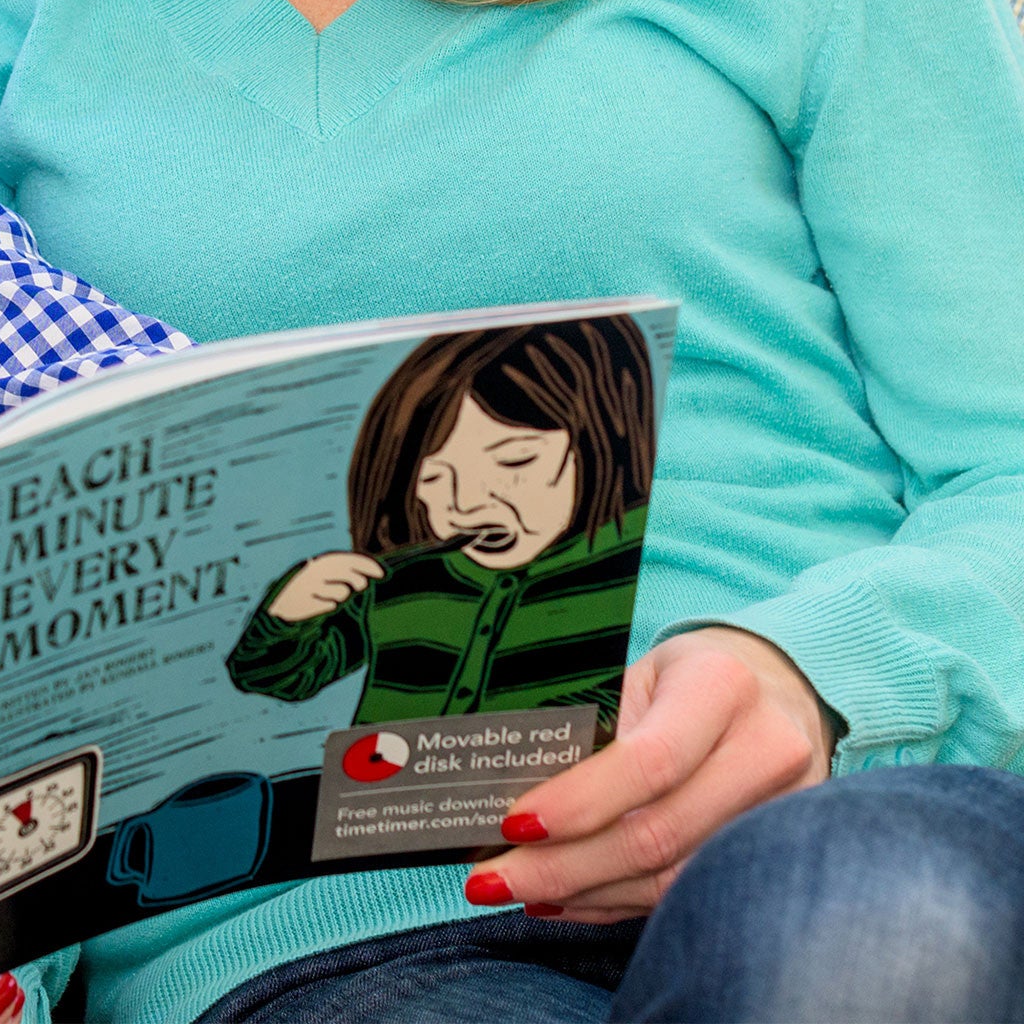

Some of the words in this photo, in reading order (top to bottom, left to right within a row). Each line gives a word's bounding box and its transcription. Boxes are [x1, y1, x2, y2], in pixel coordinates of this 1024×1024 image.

[9, 436, 154, 523] EACH
[4, 467, 218, 574] MINUTE
[1, 527, 179, 623] EVERY
[413, 755, 463, 775] disk
[470, 745, 582, 771] included!
[417, 726, 522, 752] Movable
[529, 722, 573, 744] red
[337, 807, 377, 822] Free
[382, 799, 435, 817] music
[439, 794, 516, 813] downloa
